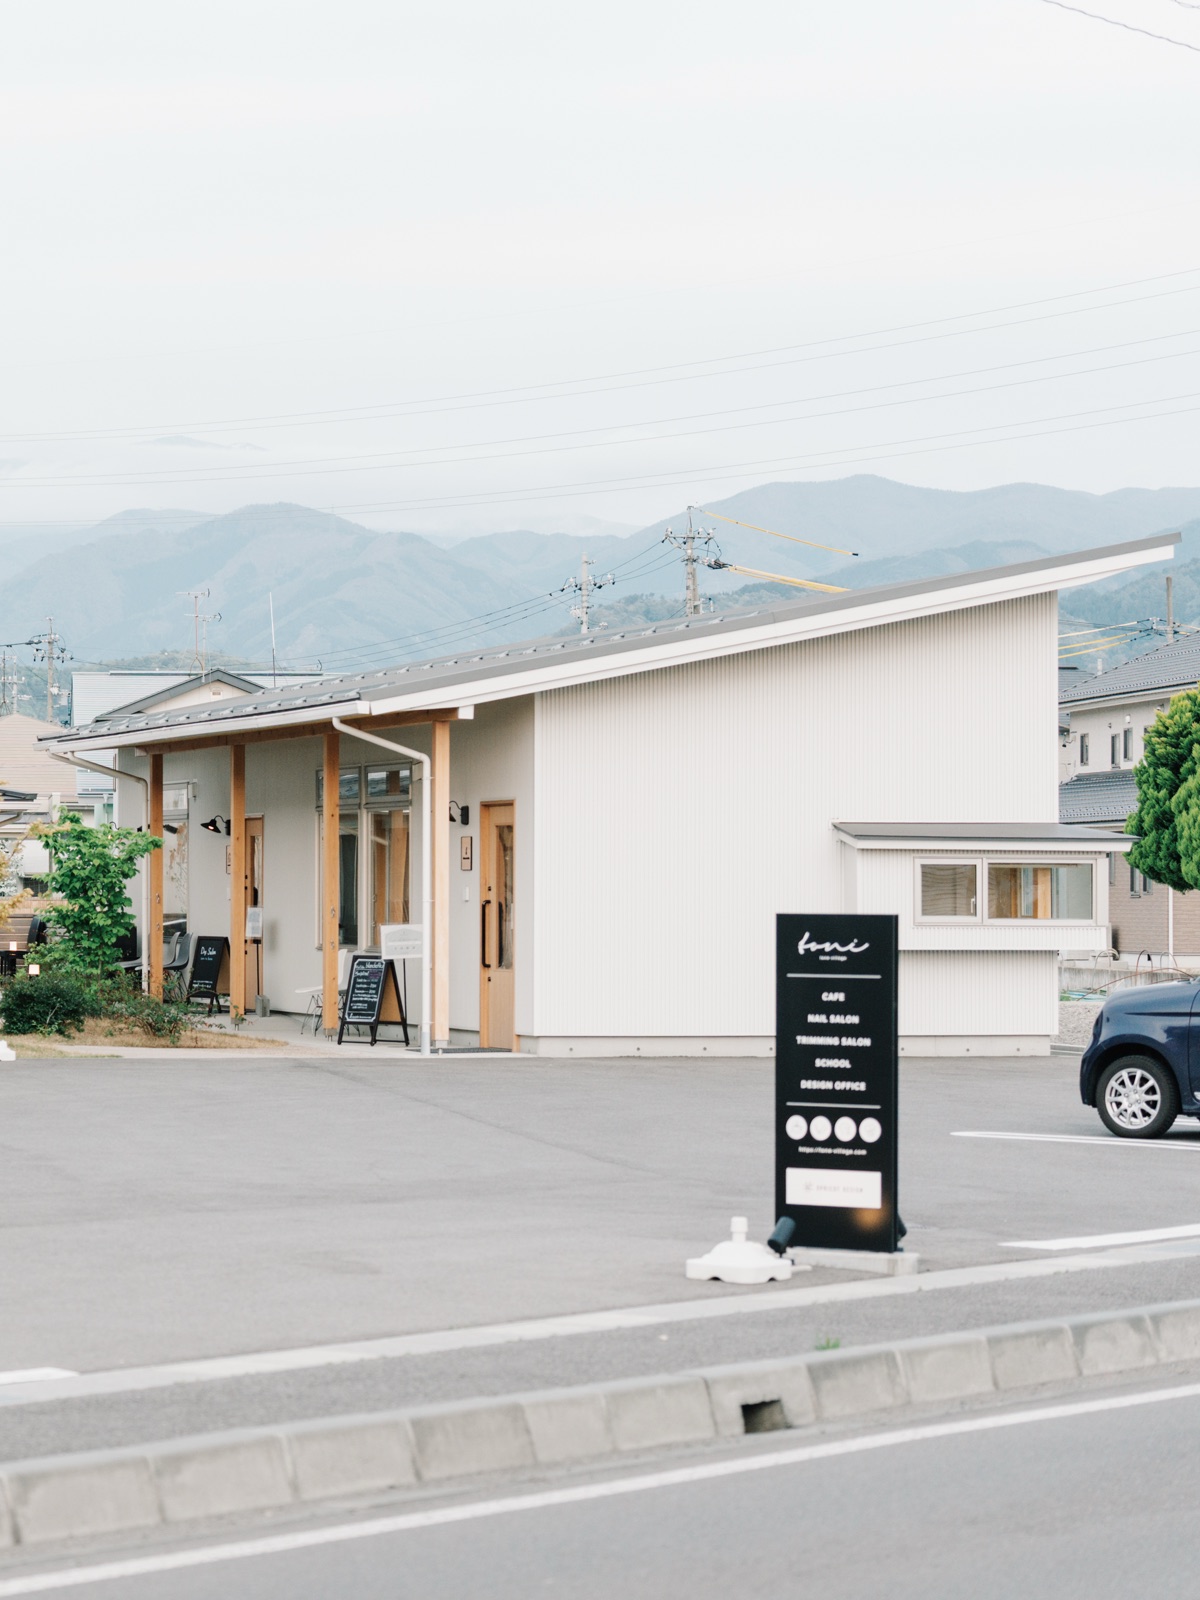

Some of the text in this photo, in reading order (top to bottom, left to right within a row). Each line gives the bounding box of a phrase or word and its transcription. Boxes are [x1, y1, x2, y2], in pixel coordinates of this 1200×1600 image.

[821, 992, 846, 1002] CAFE
[807, 1014, 860, 1025] NAIL SALON
[796, 1035, 872, 1047] TRIMMING SALON
[815, 1058, 852, 1068] SCHOOL
[800, 1079, 867, 1091] DESIGN OFFICE
